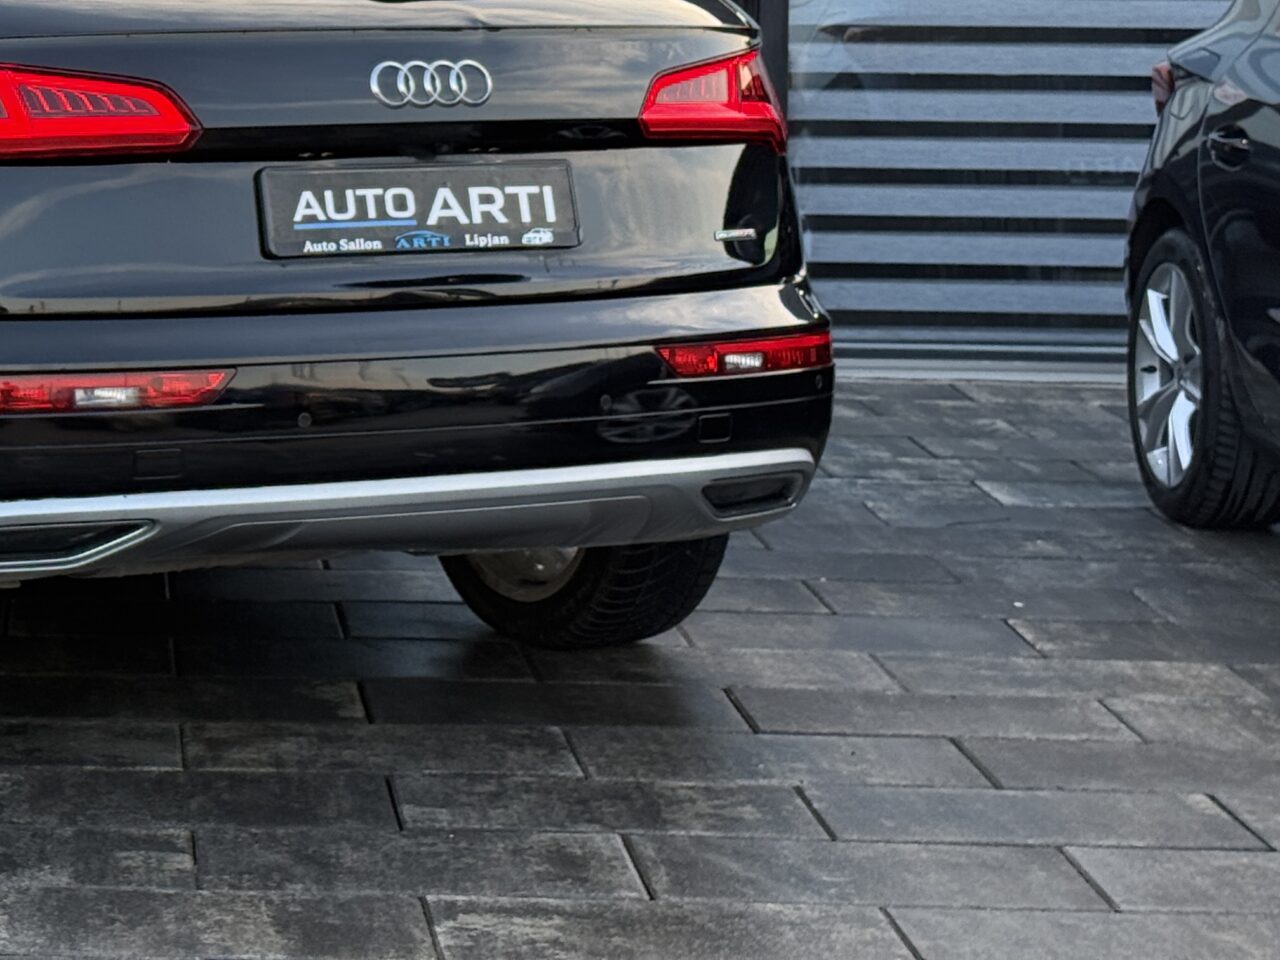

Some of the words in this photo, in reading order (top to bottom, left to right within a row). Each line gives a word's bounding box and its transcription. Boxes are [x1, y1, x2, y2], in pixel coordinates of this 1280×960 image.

[293, 187, 416, 222] AUTO
[426, 185, 557, 226] ARTI
[303, 240, 337, 253] Auto
[395, 235, 451, 249] ARTI
[464, 233, 510, 247] Lipjan
